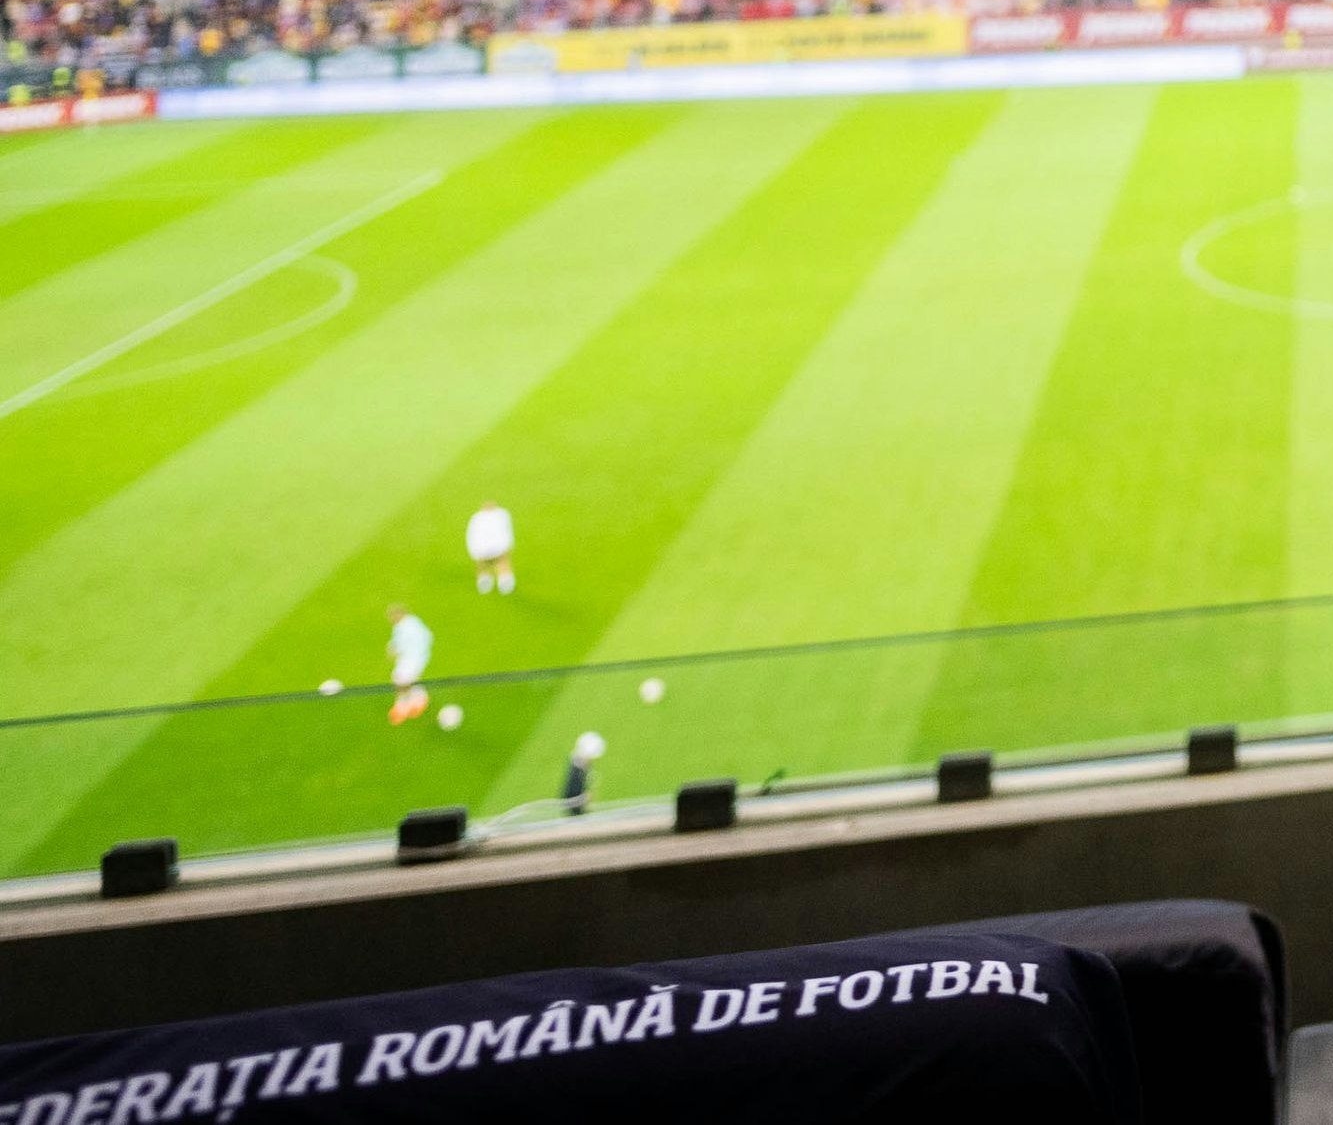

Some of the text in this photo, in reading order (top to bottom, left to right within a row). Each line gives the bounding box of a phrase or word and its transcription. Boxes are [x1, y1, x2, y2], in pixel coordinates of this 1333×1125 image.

[357, 984, 680, 1083] ROMÂNĂ
[692, 981, 787, 1032] DE
[795, 959, 1049, 1016] FOTBAL
